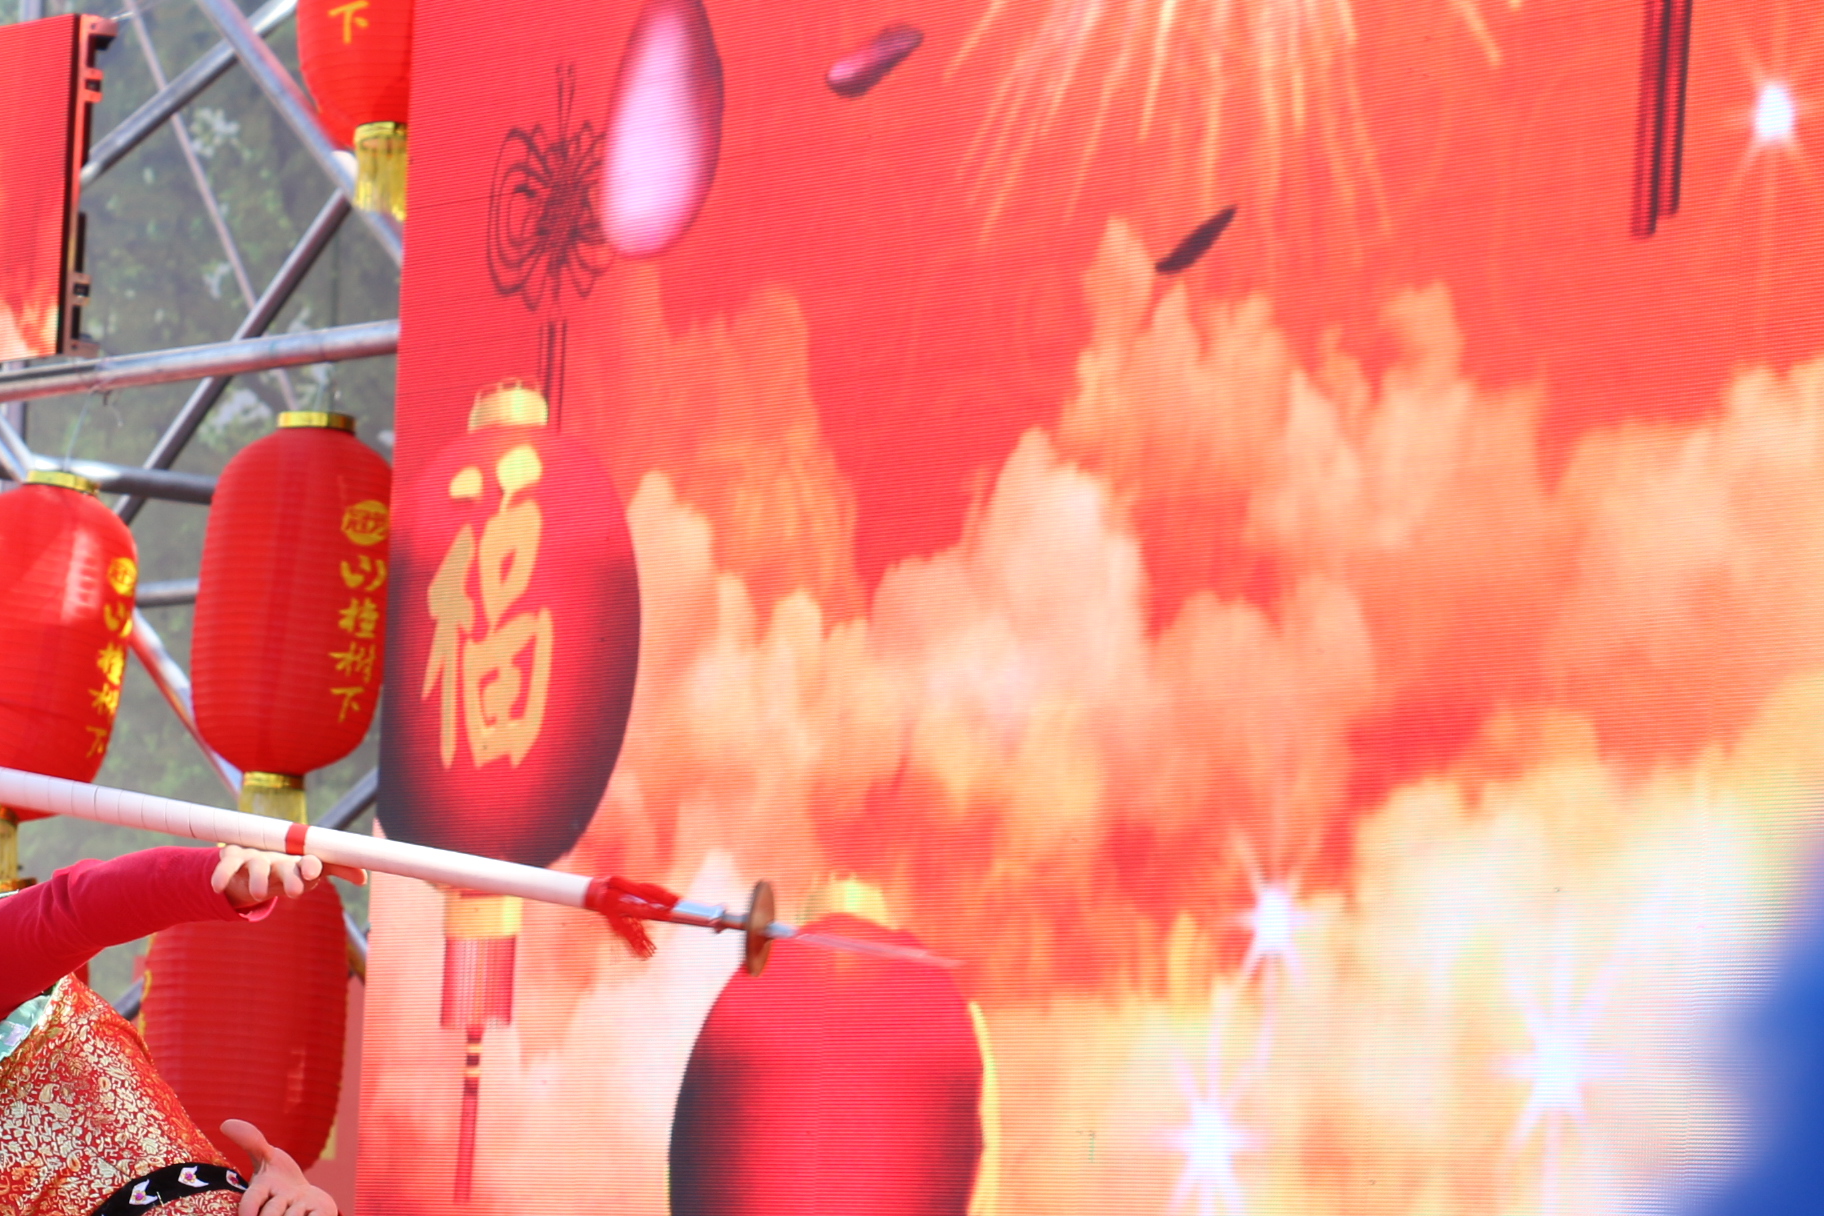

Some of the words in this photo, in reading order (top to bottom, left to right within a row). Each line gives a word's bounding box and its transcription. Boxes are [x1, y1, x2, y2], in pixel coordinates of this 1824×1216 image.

[327, 0, 370, 44] 下
[328, 554, 388, 723] 山楂树下
[421, 444, 554, 768] 福
